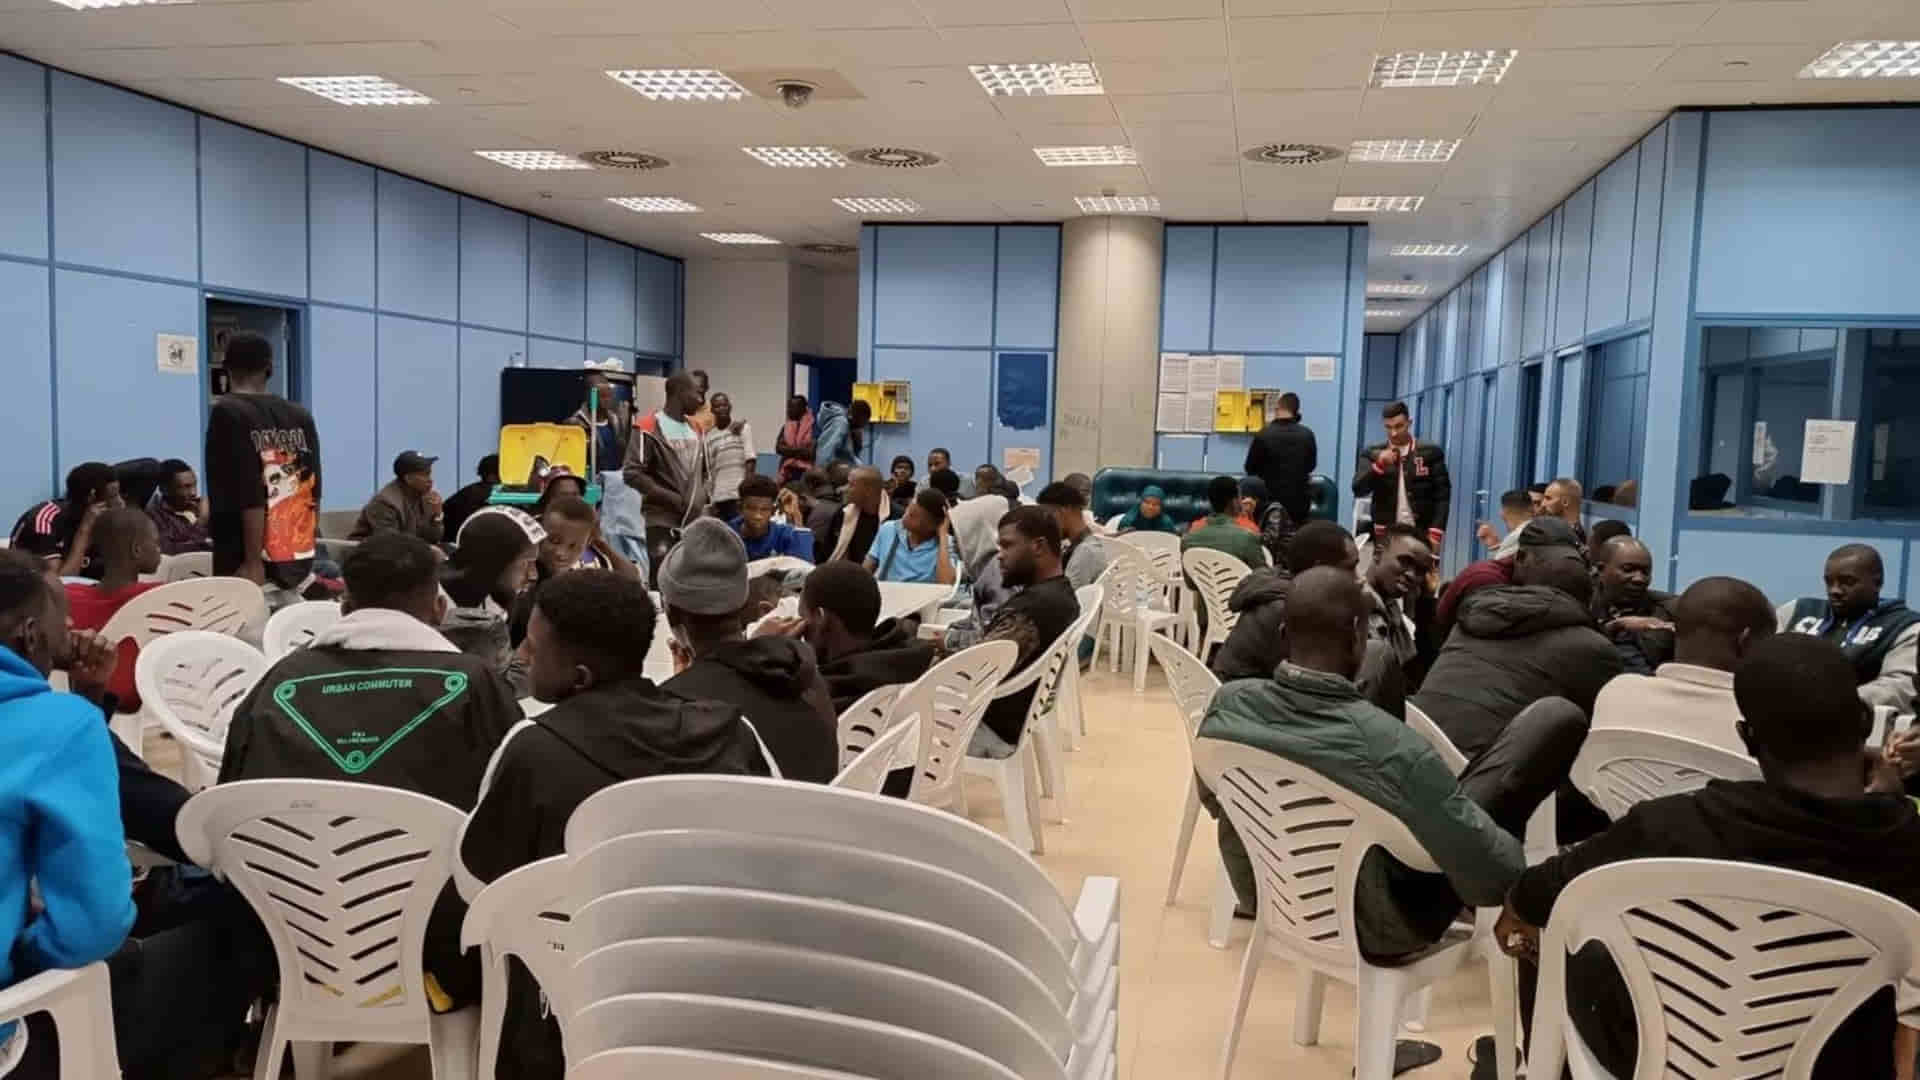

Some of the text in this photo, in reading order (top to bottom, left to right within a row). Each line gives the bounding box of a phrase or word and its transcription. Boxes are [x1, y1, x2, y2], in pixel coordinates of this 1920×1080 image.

[1414, 456, 1429, 476] L
[322, 679, 413, 694] URBAN COMMUTER
